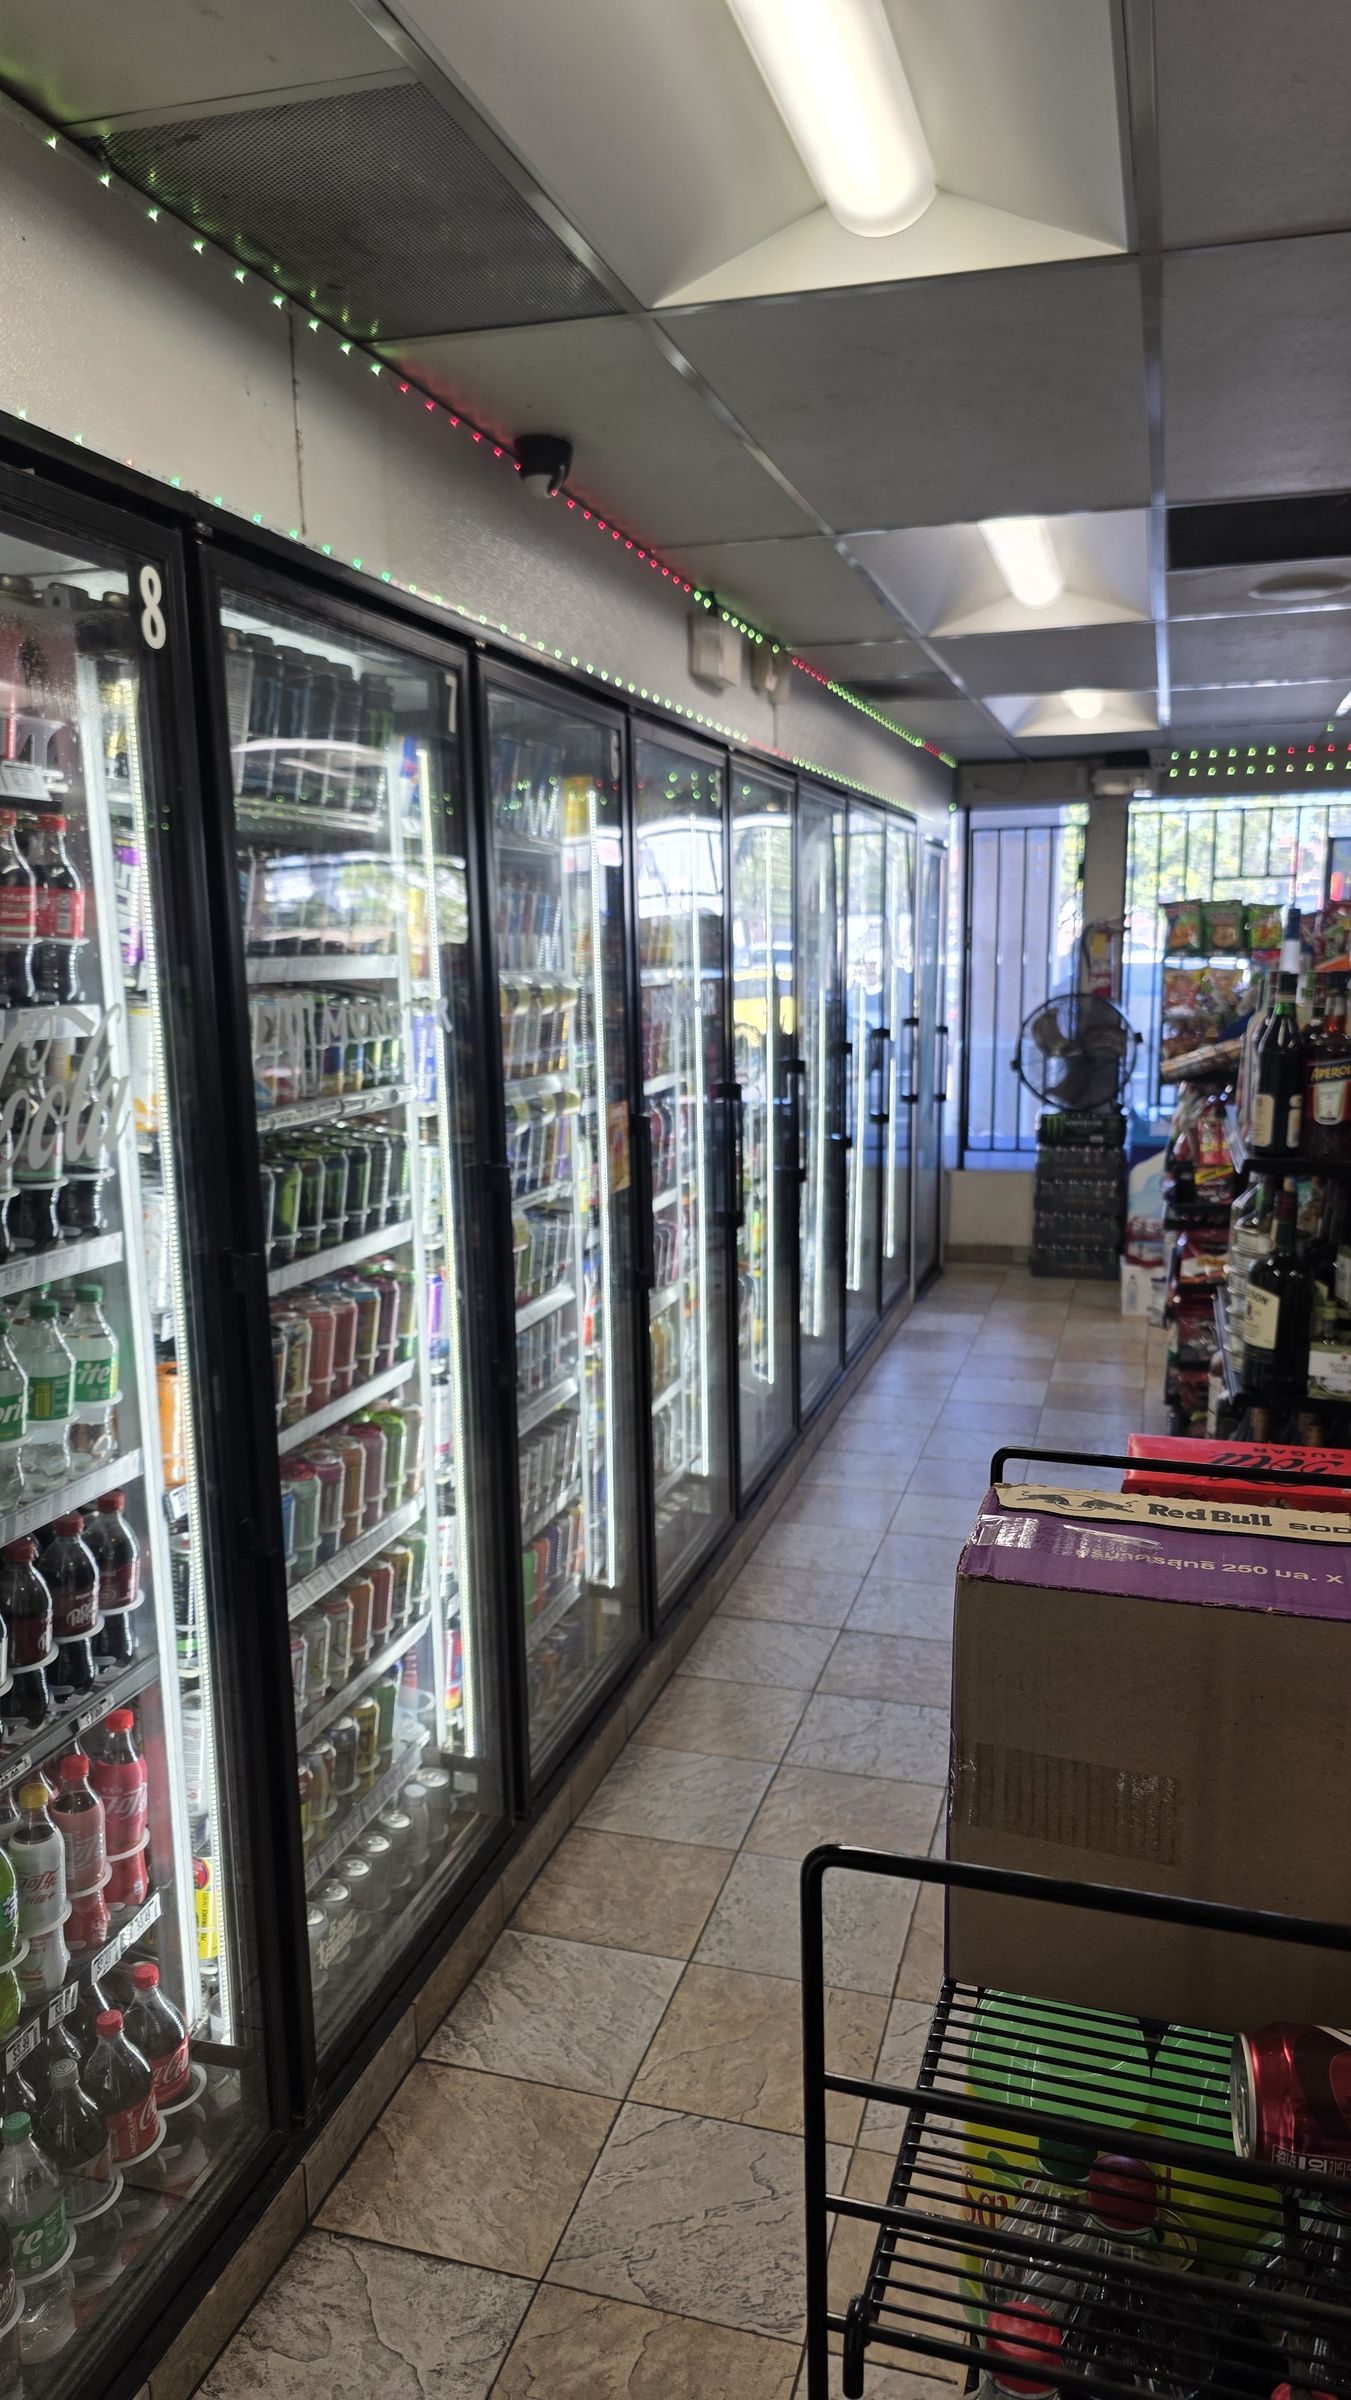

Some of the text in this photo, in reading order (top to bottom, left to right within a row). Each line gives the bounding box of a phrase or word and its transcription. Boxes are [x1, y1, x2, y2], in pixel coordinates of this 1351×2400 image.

[139, 565, 167, 650] 8
[444, 671, 459, 734] 7
[1253, 1447, 1345, 1460] SUGAR
[1147, 1502, 1207, 1522] Red
[1211, 1510, 1273, 1527] Bull
[1221, 1563, 1268, 1576] 250
[1275, 1568, 1317, 1582] มล.
